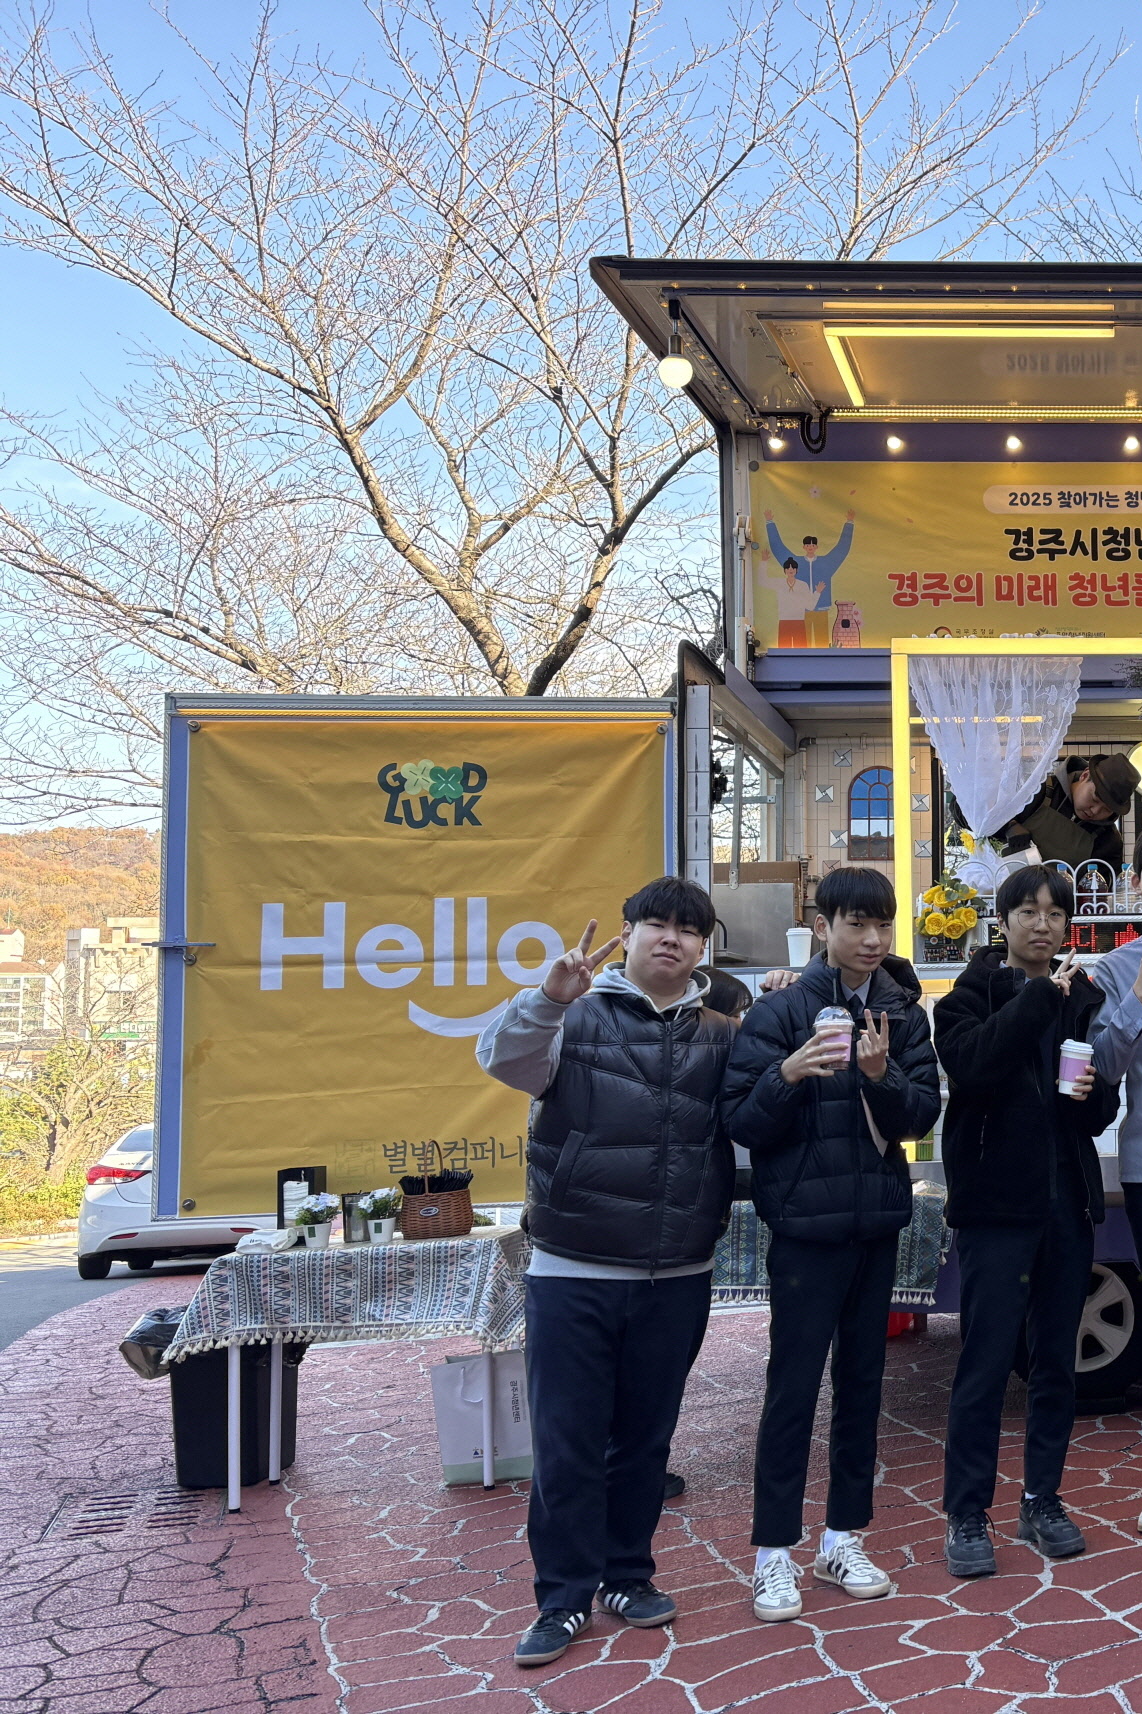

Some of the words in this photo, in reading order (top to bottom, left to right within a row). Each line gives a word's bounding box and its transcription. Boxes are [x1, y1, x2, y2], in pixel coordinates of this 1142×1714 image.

[1008, 491, 1052, 507] 2025
[1057, 490, 1120, 508] 찾아가는
[887, 571, 984, 607] 경주의
[994, 572, 1058, 607] 미래
[384, 793, 483, 829] LUCK
[258, 896, 565, 991] Hello
